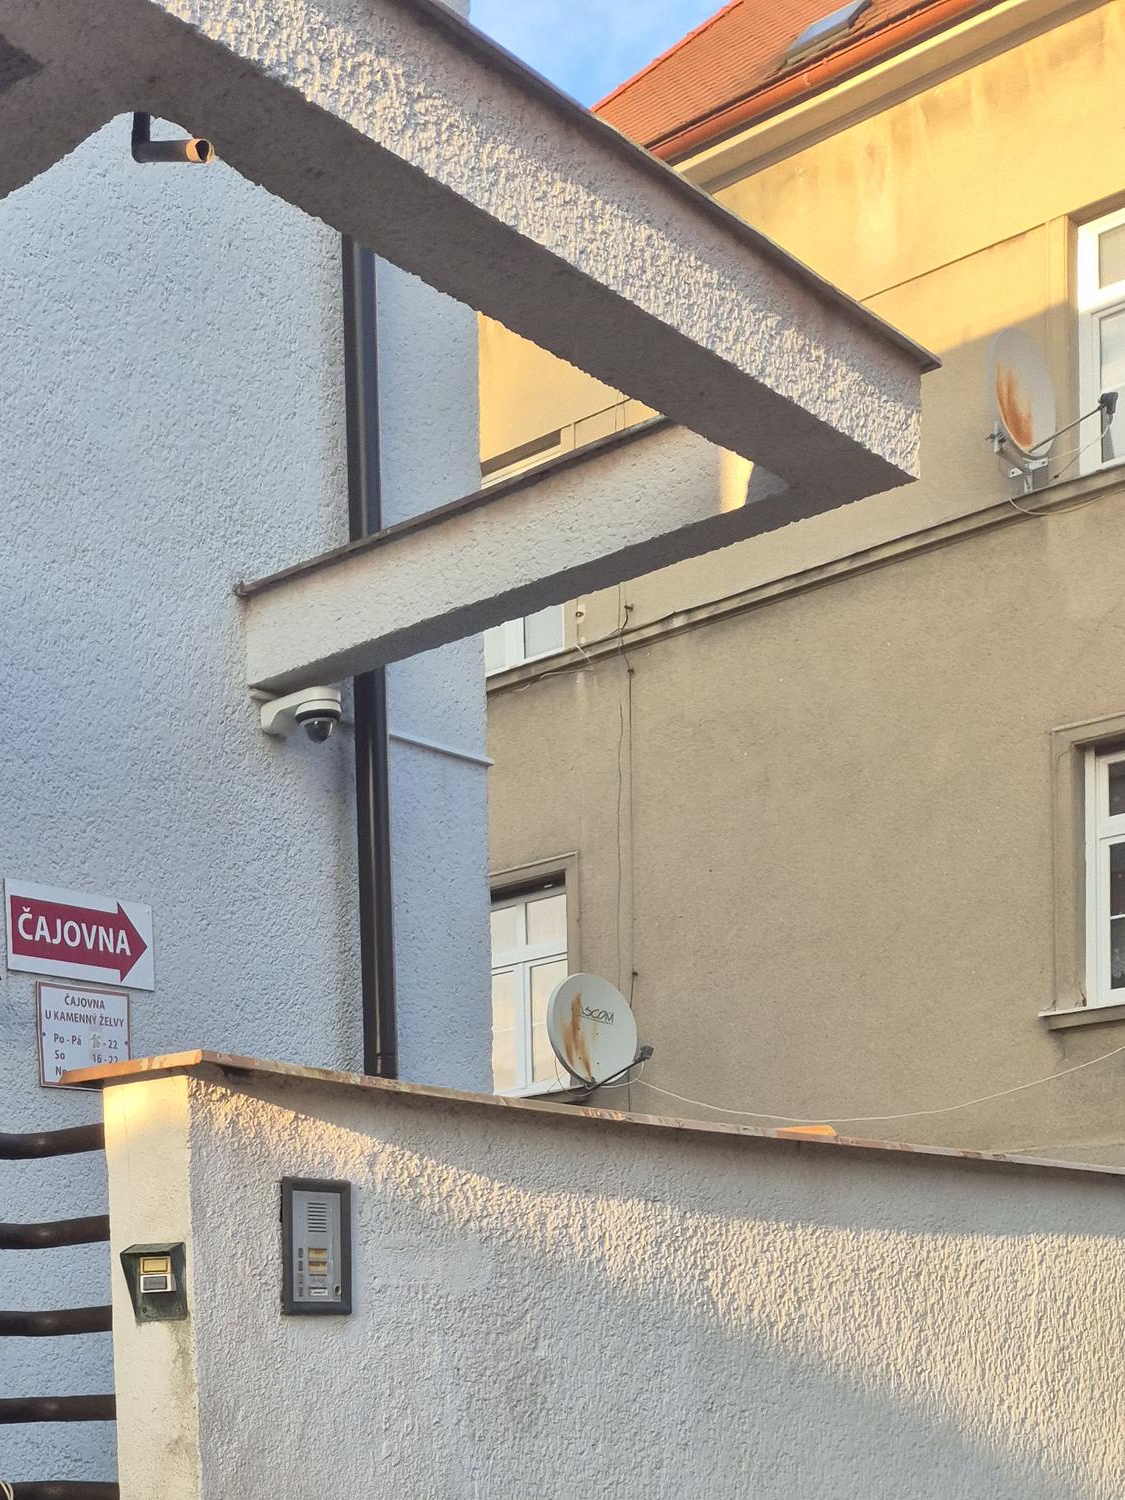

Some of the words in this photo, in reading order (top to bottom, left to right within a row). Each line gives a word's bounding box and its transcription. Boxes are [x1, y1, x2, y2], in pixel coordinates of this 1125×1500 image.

[17, 906, 132, 956] ČAJOVNA
[64, 993, 106, 1010] ČAJOVNA
[45, 1009, 52, 1020] U
[53, 1010, 97, 1025] KAMENNÝ
[99, 1013, 125, 1028] ŽELVY
[53, 1033, 65, 1044] Po
[71, 1035, 82, 1046] Pá
[108, 1039, 118, 1049] 22
[55, 1050, 66, 1060] So
[92, 1054, 102, 1064] 16
